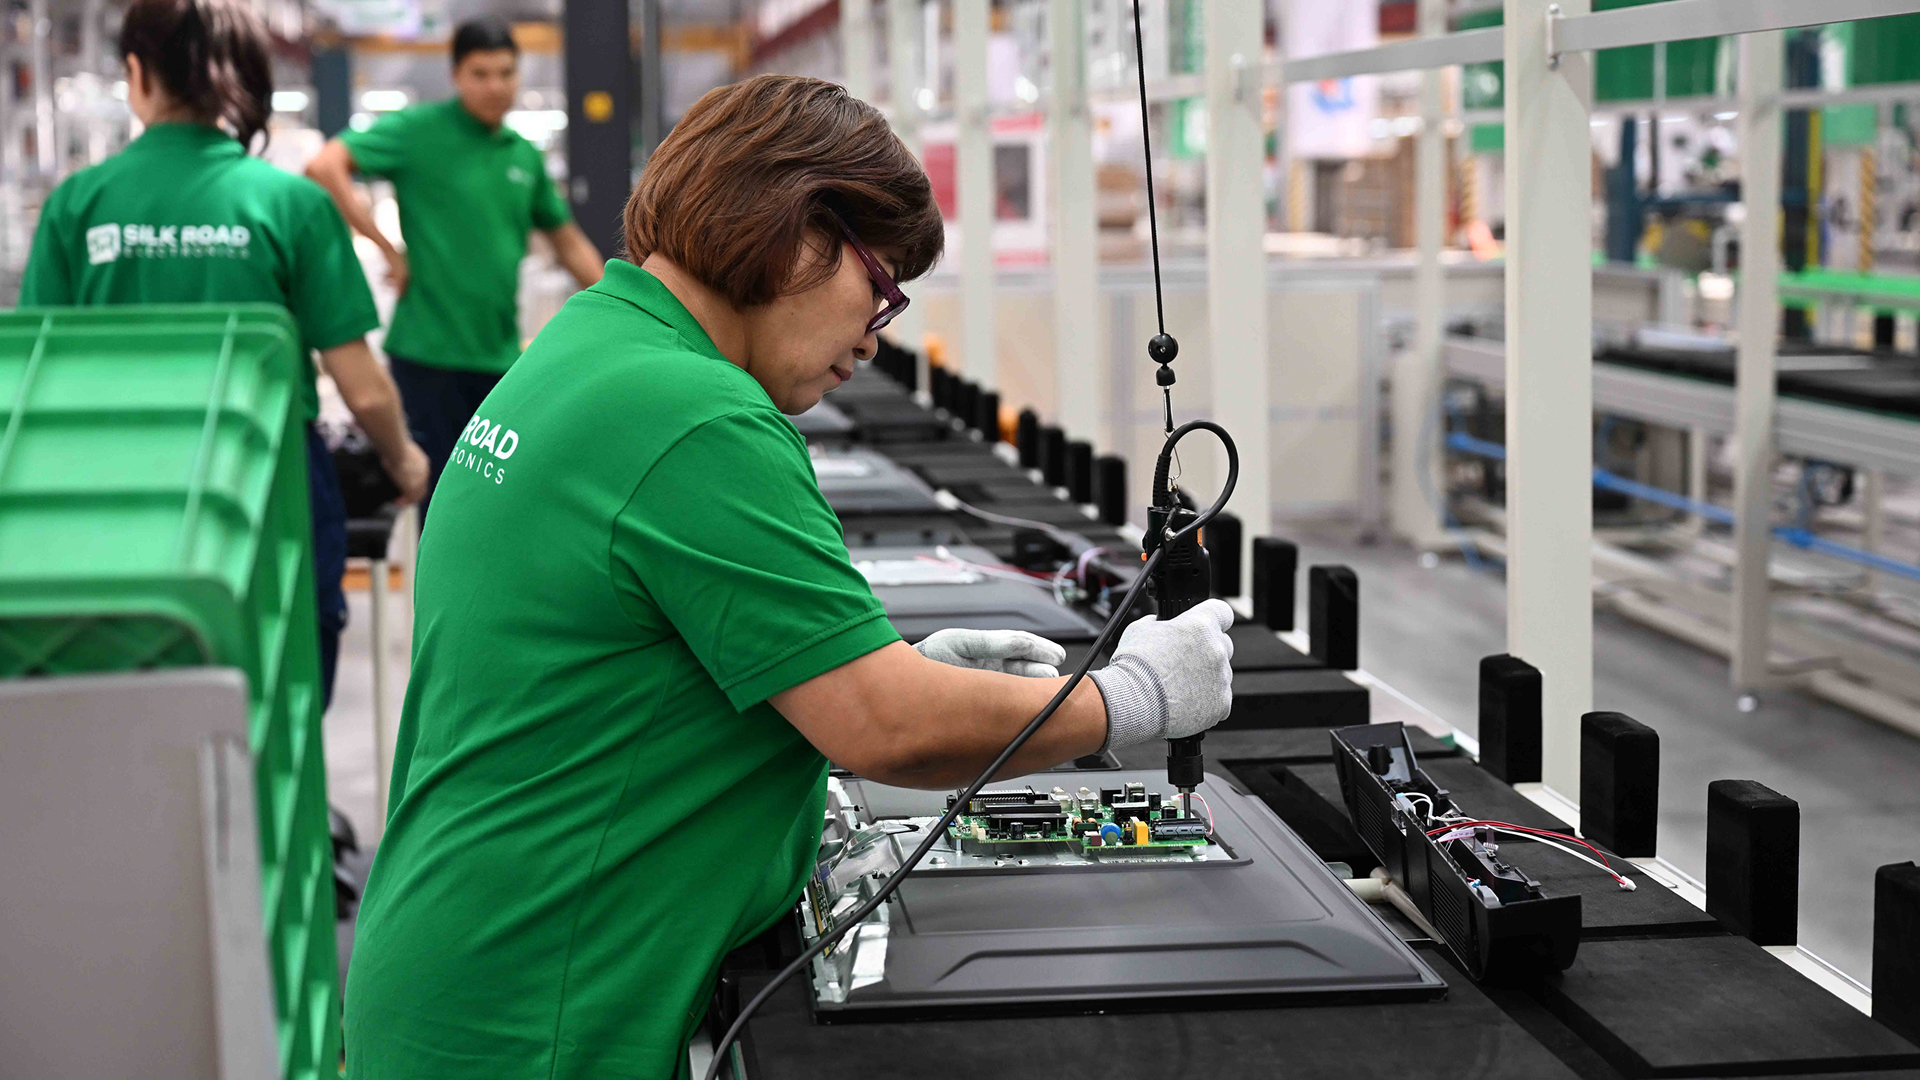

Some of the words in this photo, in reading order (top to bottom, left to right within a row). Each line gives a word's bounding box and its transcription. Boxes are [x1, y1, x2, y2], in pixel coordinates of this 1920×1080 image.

[123, 224, 178, 246] SILK
[181, 225, 251, 247] ROAD
[461, 415, 519, 460] ROAD
